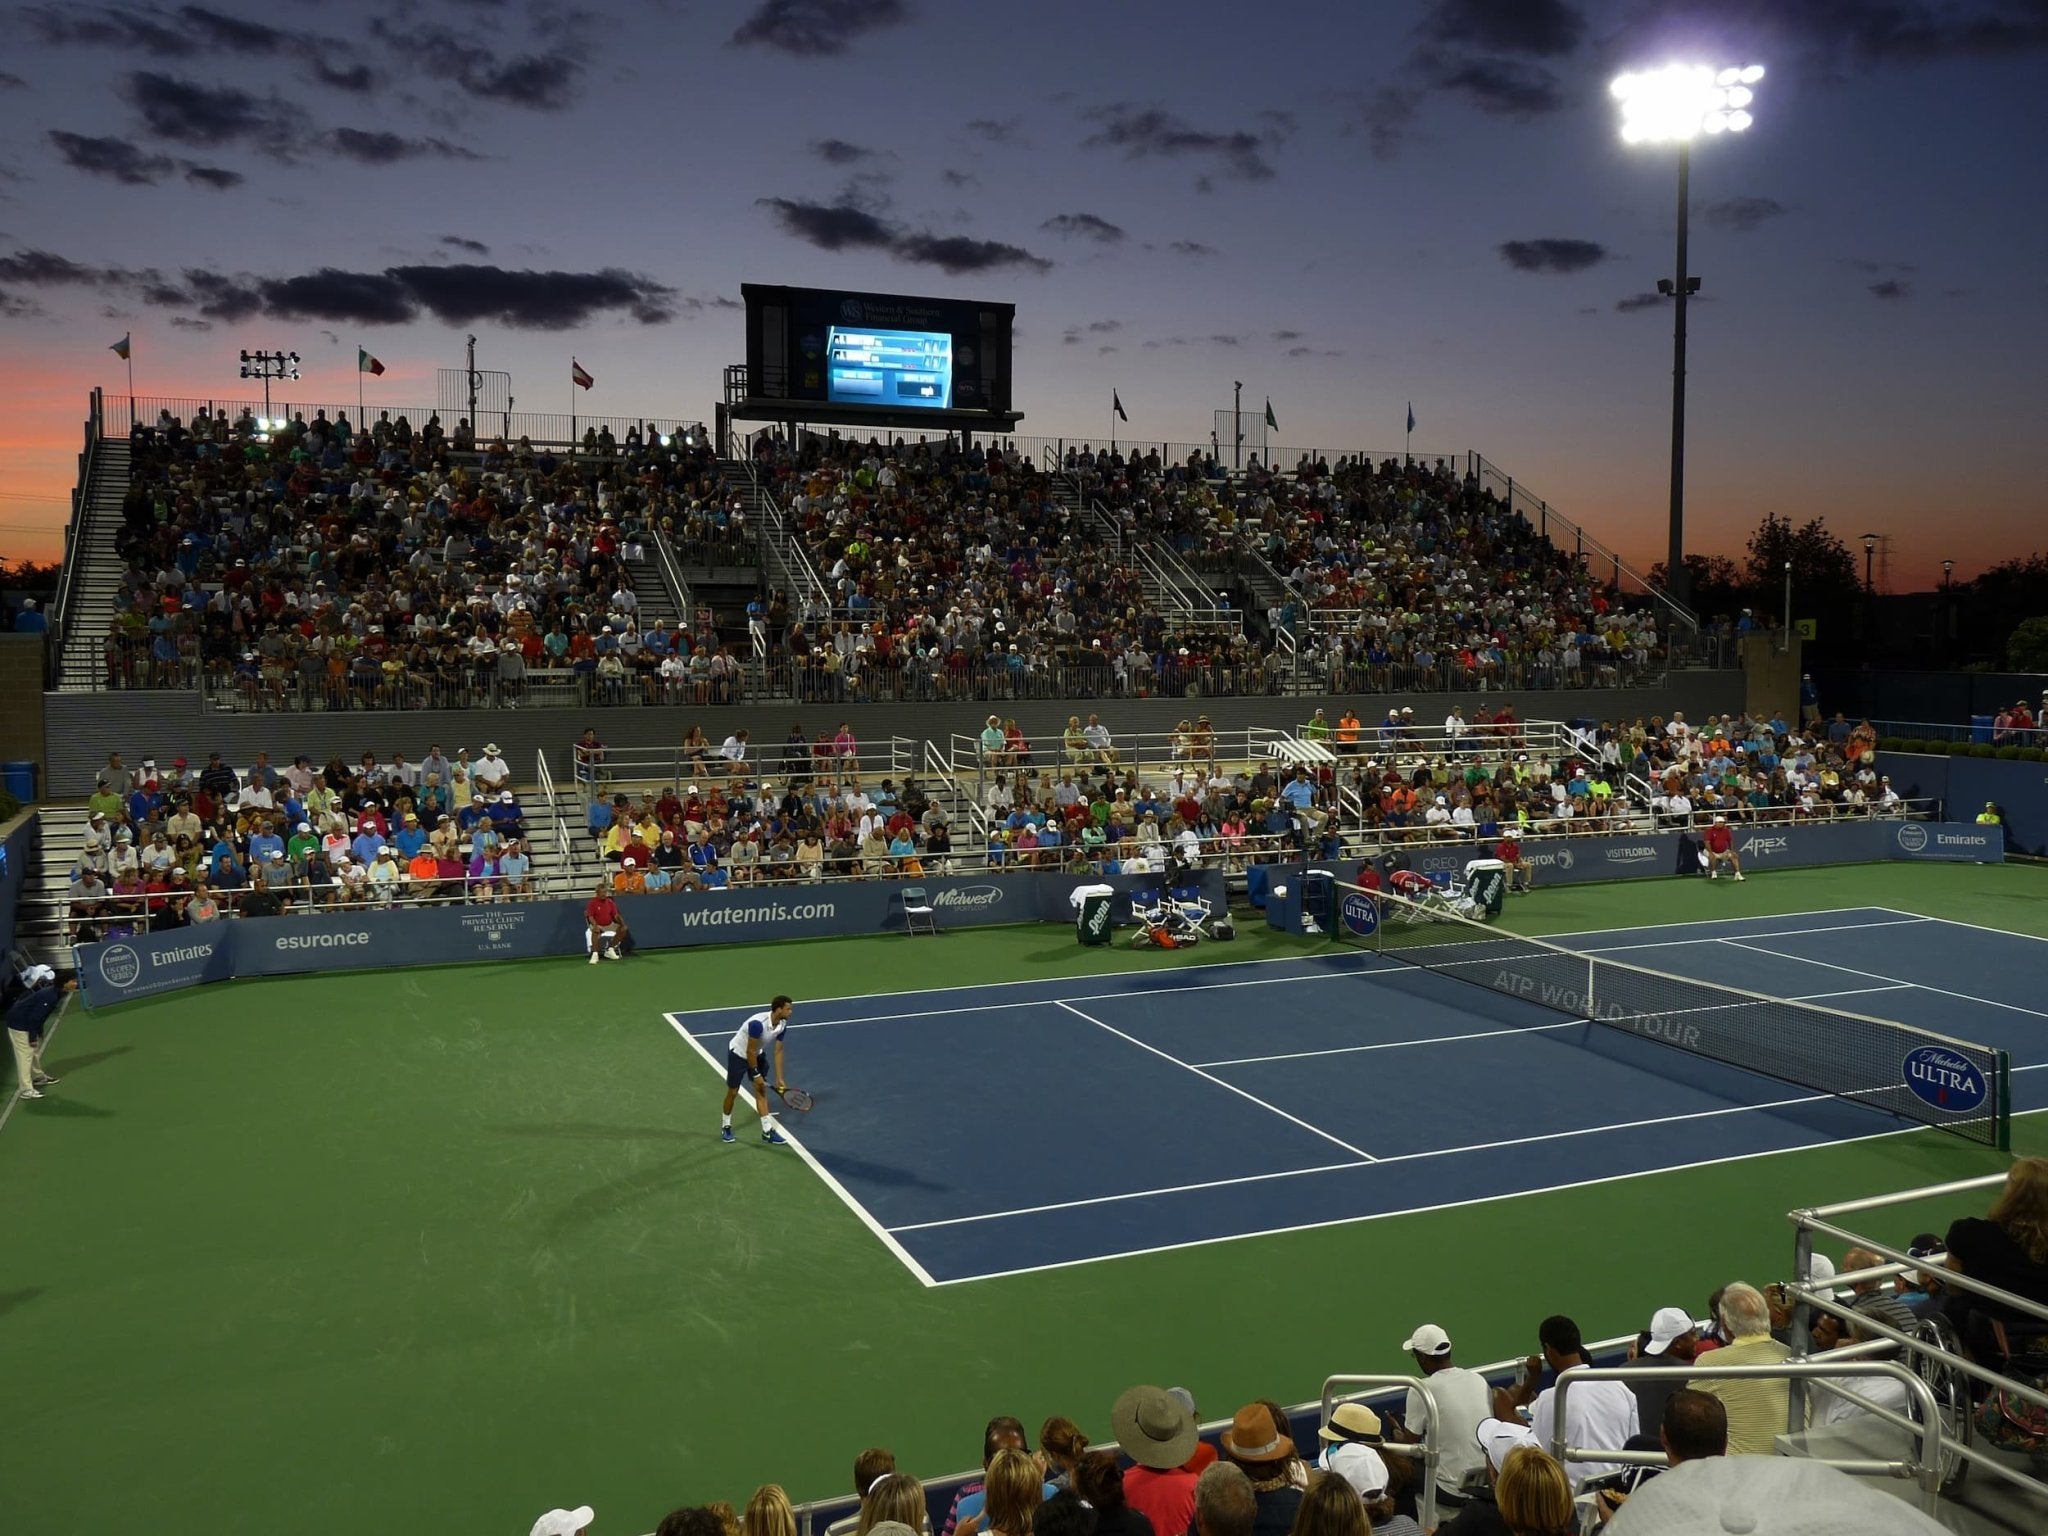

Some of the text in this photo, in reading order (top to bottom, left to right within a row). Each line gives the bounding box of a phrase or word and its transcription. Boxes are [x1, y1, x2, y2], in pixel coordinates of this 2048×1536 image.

[1801, 624, 1810, 637] 3
[1937, 833, 1987, 846] Emirates
[1422, 856, 1458, 871] OREO
[932, 888, 996, 906] Midwest
[682, 902, 835, 927] wtatennis.com
[1345, 904, 1375, 923] ULTRA
[474, 923, 516, 932] RESERVE
[276, 932, 369, 949] esurance
[152, 944, 213, 967] Emirates
[1494, 970, 1700, 1047] ATP WORLD TOUR
[1911, 1061, 1977, 1094] ULTRA
